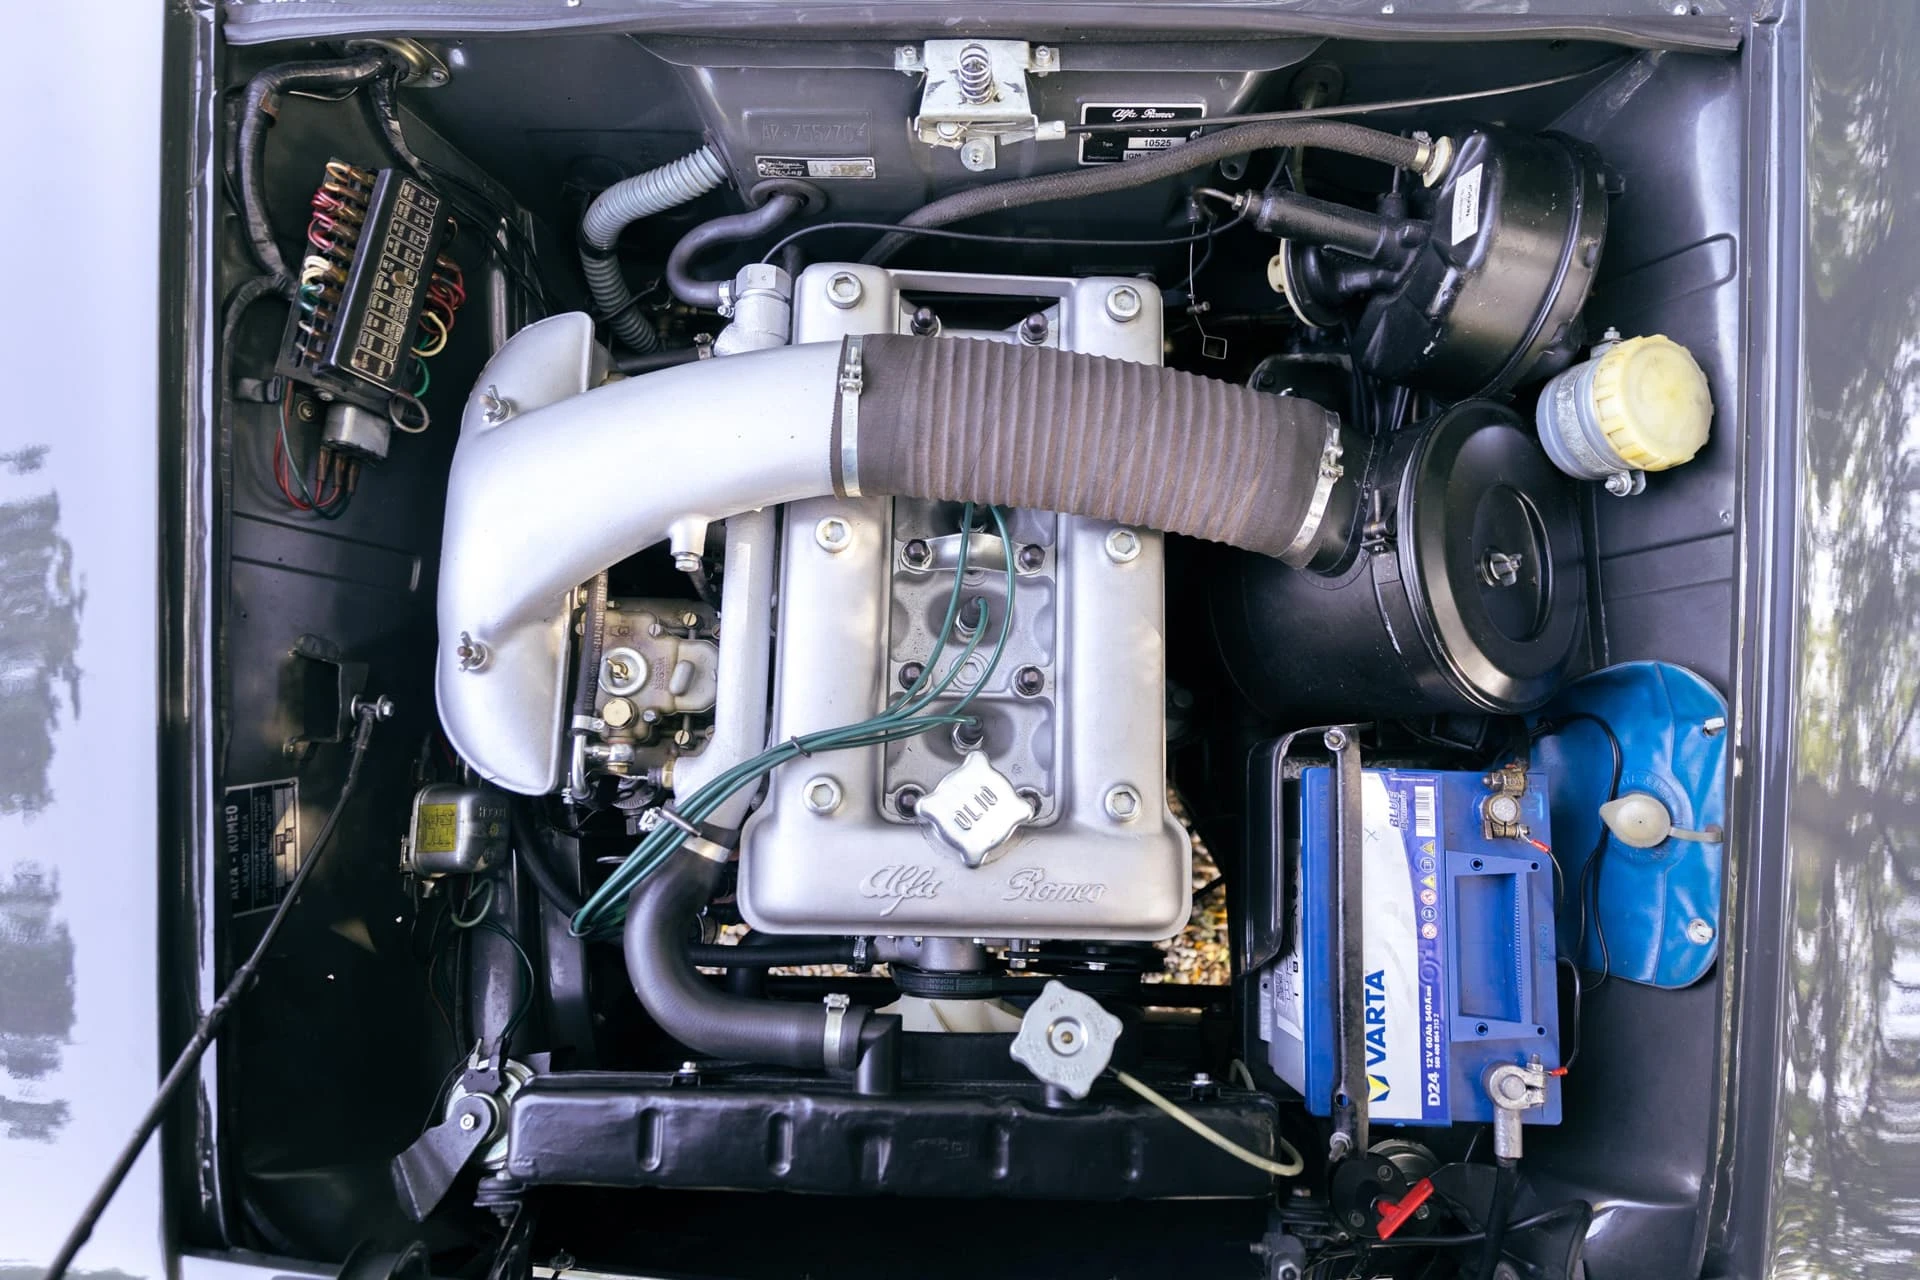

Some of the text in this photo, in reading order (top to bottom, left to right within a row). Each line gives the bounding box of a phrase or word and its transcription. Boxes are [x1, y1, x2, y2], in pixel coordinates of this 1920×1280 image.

[1112, 108, 1175, 122] Alfa Romeo
[1144, 139, 1172, 147] 10525
[953, 785, 999, 831] OLIO
[1388, 791, 1400, 828] BLUE
[860, 865, 1107, 917] Alfa Romeo
[1365, 969, 1386, 1068] VARTA
[1425, 1024, 1433, 1049] 60Ah
[1427, 1071, 1441, 1106] D24
